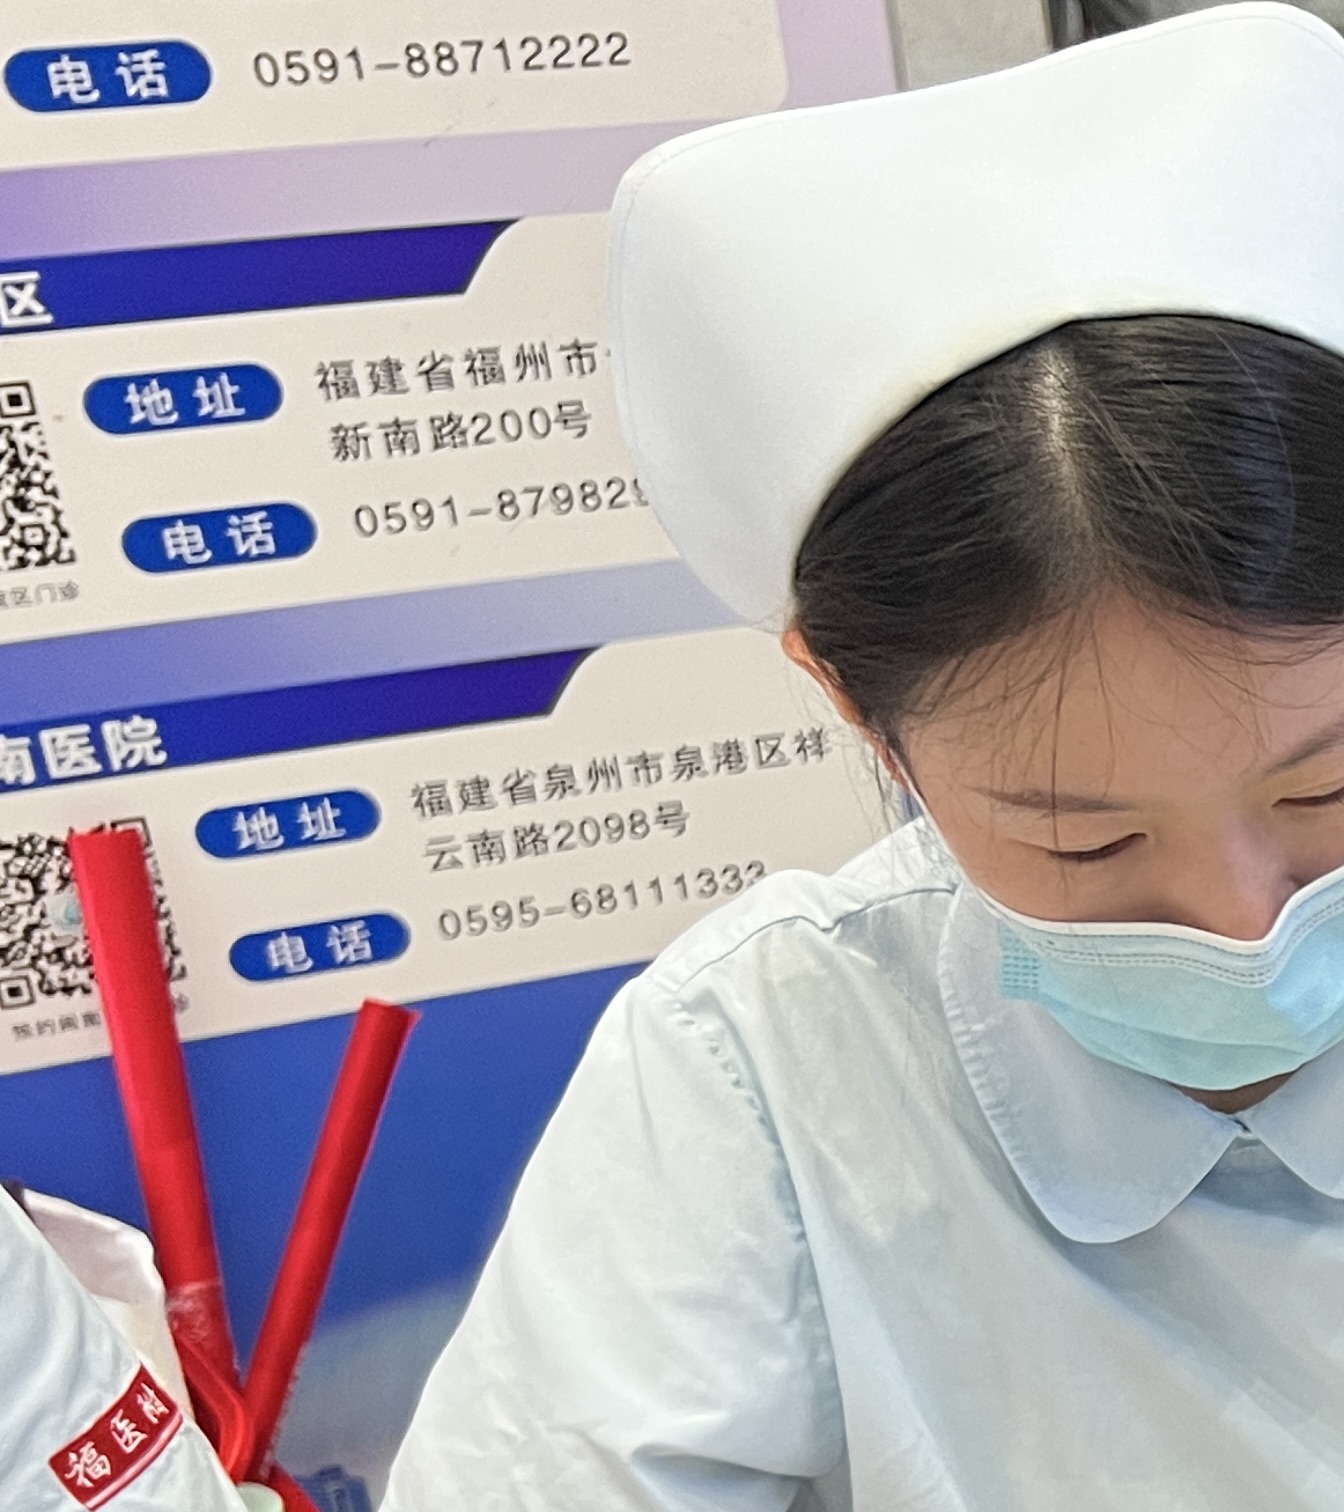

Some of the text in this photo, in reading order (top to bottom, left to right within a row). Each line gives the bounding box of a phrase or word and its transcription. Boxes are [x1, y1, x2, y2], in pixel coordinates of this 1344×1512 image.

[46, 51, 169, 106] 电话
[253, 31, 631, 89] 0591-88712222
[314, 338, 602, 404] 福建省福州市
[125, 373, 246, 429] 地址
[330, 401, 592, 463] 新南路200号
[162, 511, 275, 566] 电话
[0, 579, 80, 610] 区门诊
[411, 726, 830, 820] 福建省泉州市泉港区祥
[231, 796, 347, 852] 地址
[423, 800, 690, 874] 云南路2098号
[266, 920, 372, 975] 电话
